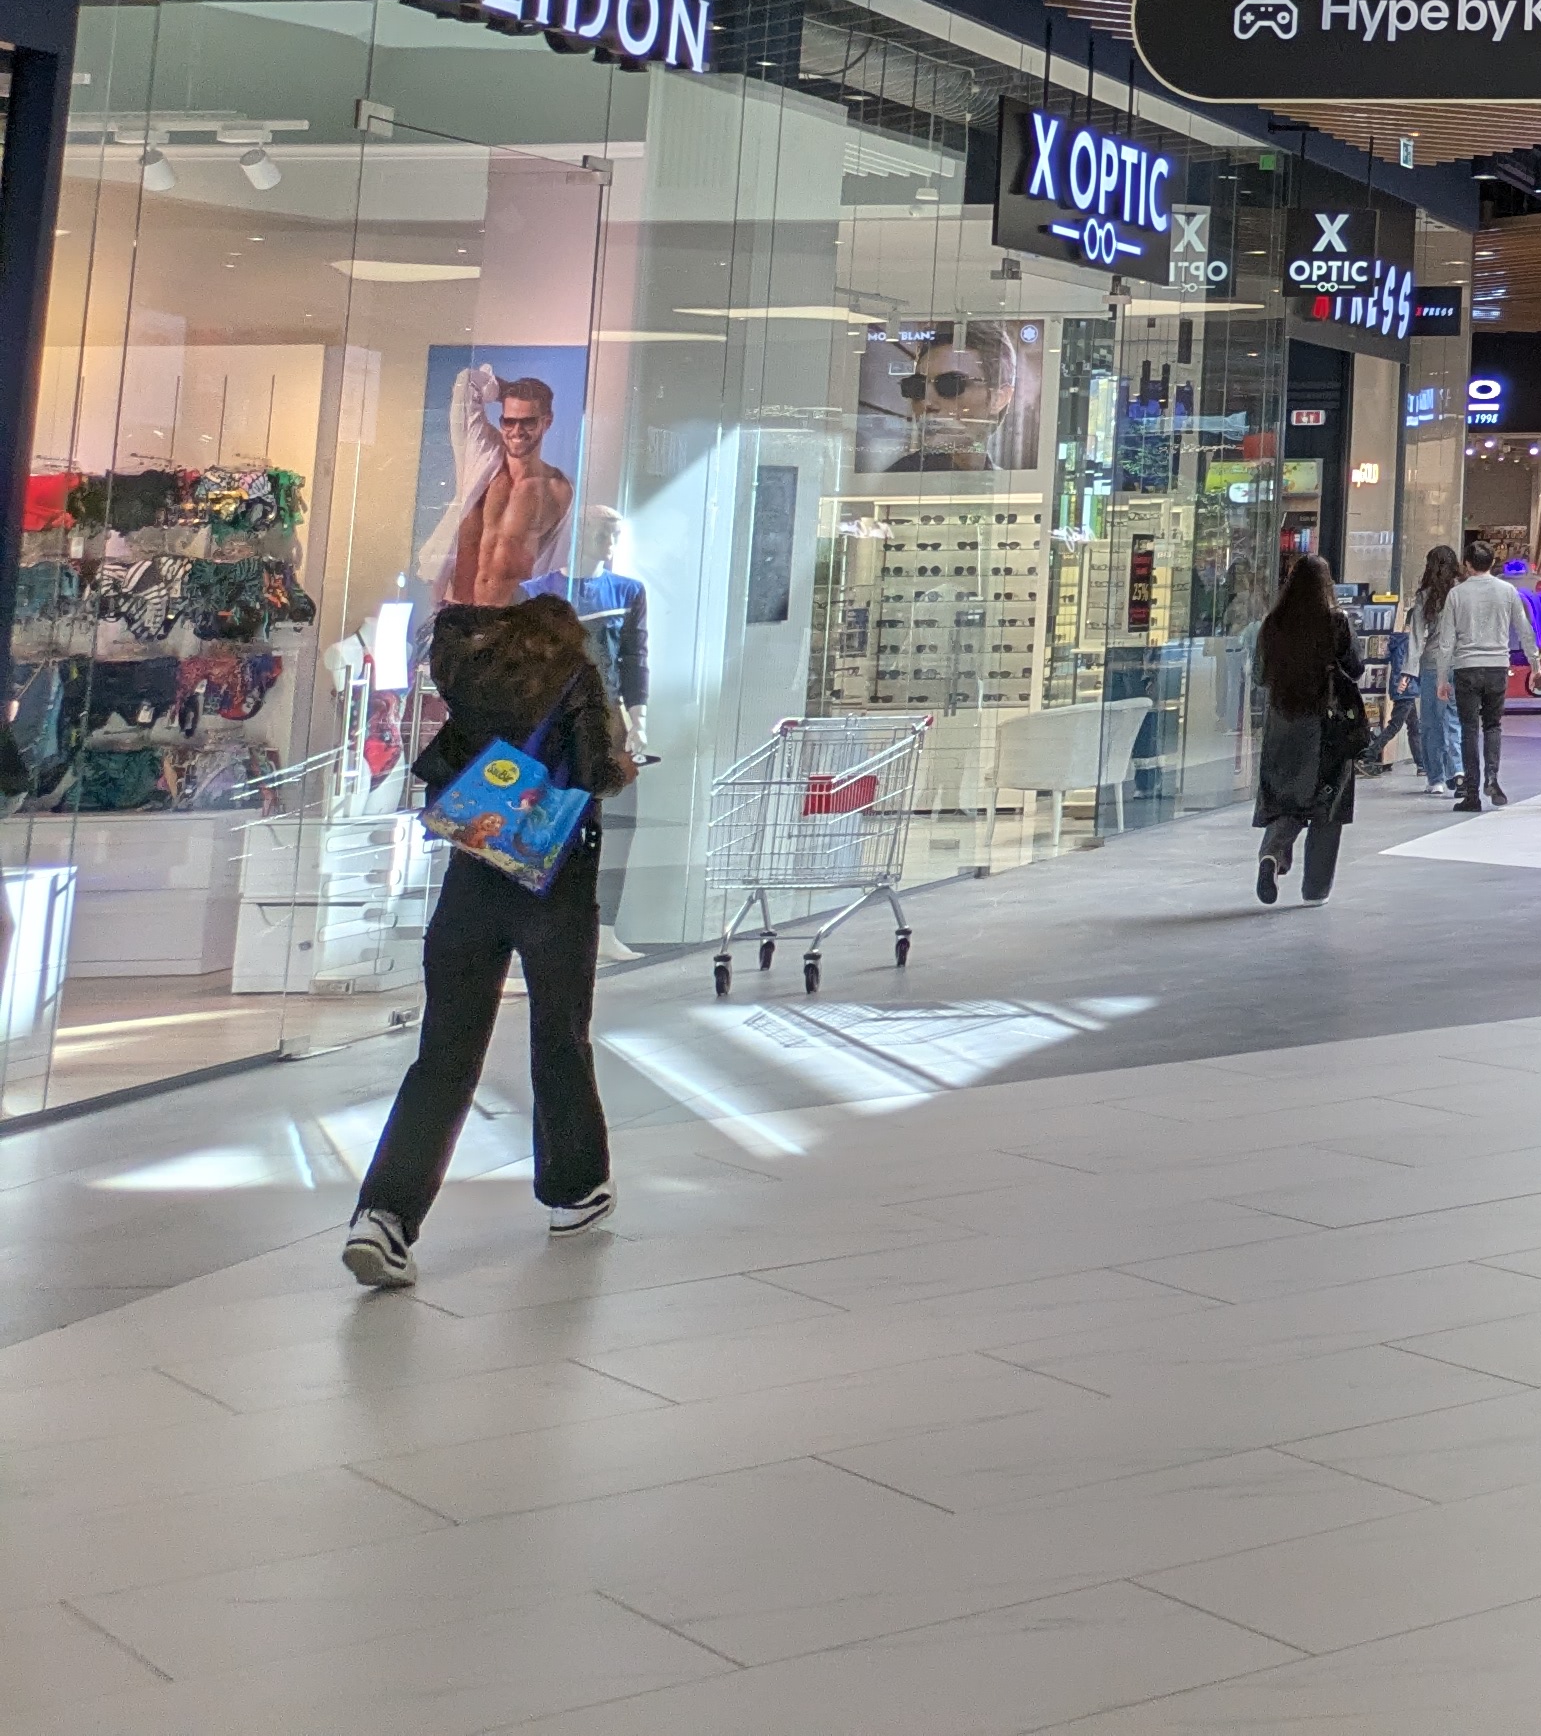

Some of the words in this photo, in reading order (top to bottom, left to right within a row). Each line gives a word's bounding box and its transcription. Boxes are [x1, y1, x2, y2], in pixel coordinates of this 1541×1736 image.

[1030, 113, 1057, 201] X
[1069, 130, 1170, 232] OPTIC
[1312, 214, 1349, 252] X
[1289, 260, 1368, 282] OPTIC
